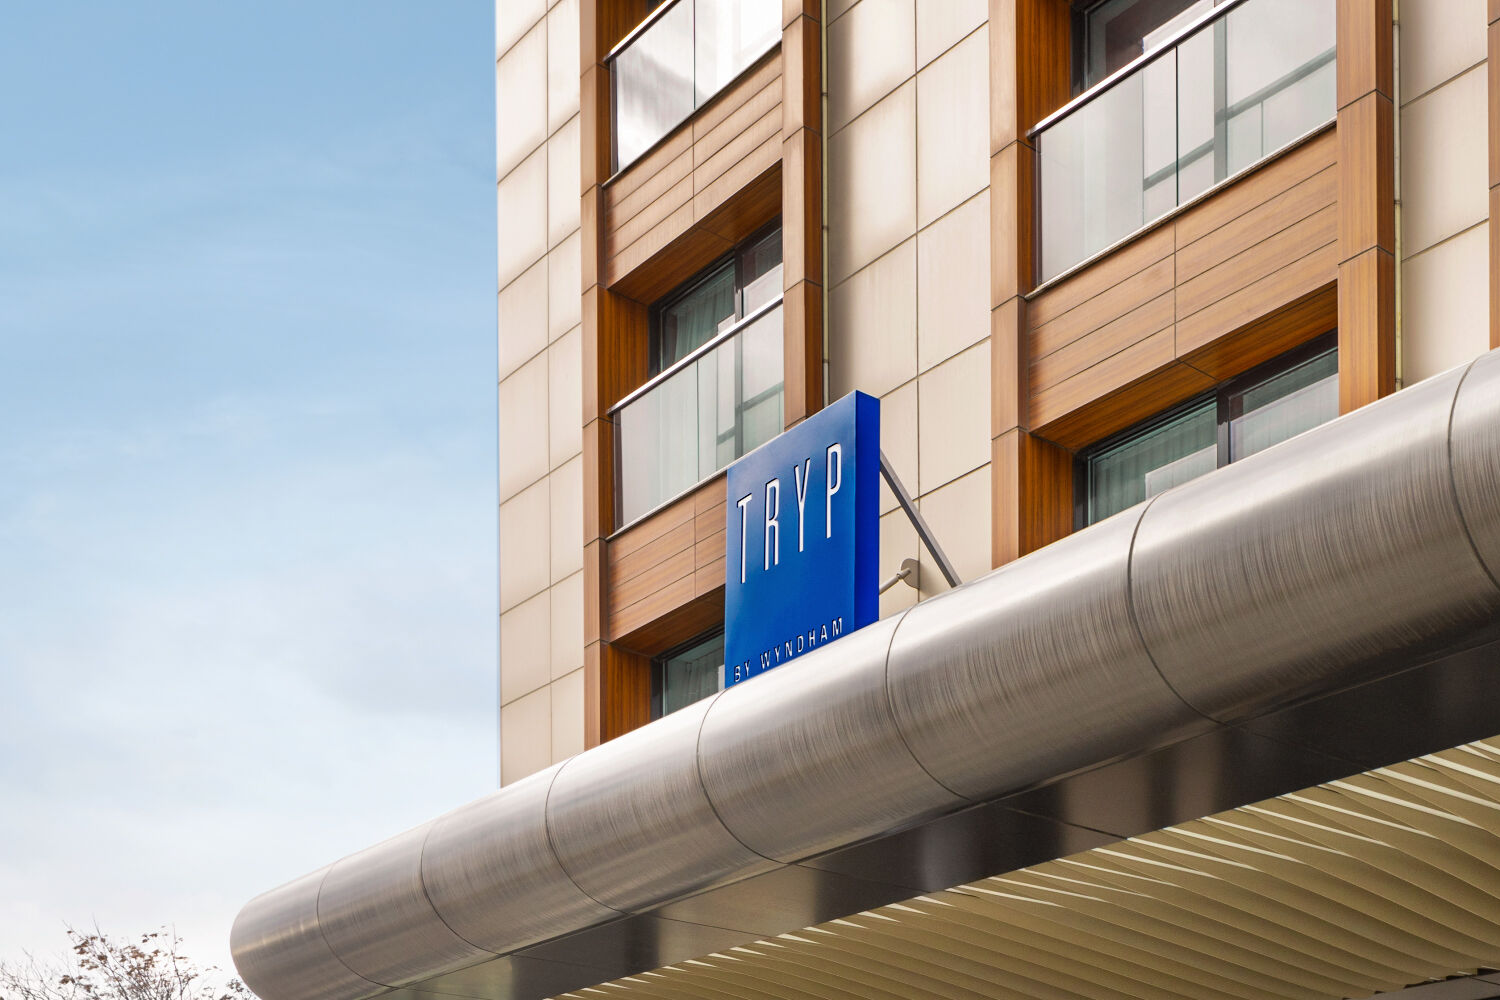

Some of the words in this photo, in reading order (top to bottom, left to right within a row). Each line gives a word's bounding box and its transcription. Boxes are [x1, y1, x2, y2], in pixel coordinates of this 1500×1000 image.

[736, 442, 843, 584] TRYP
[733, 660, 751, 683] BY
[760, 616, 843, 670] WYNDHAM
